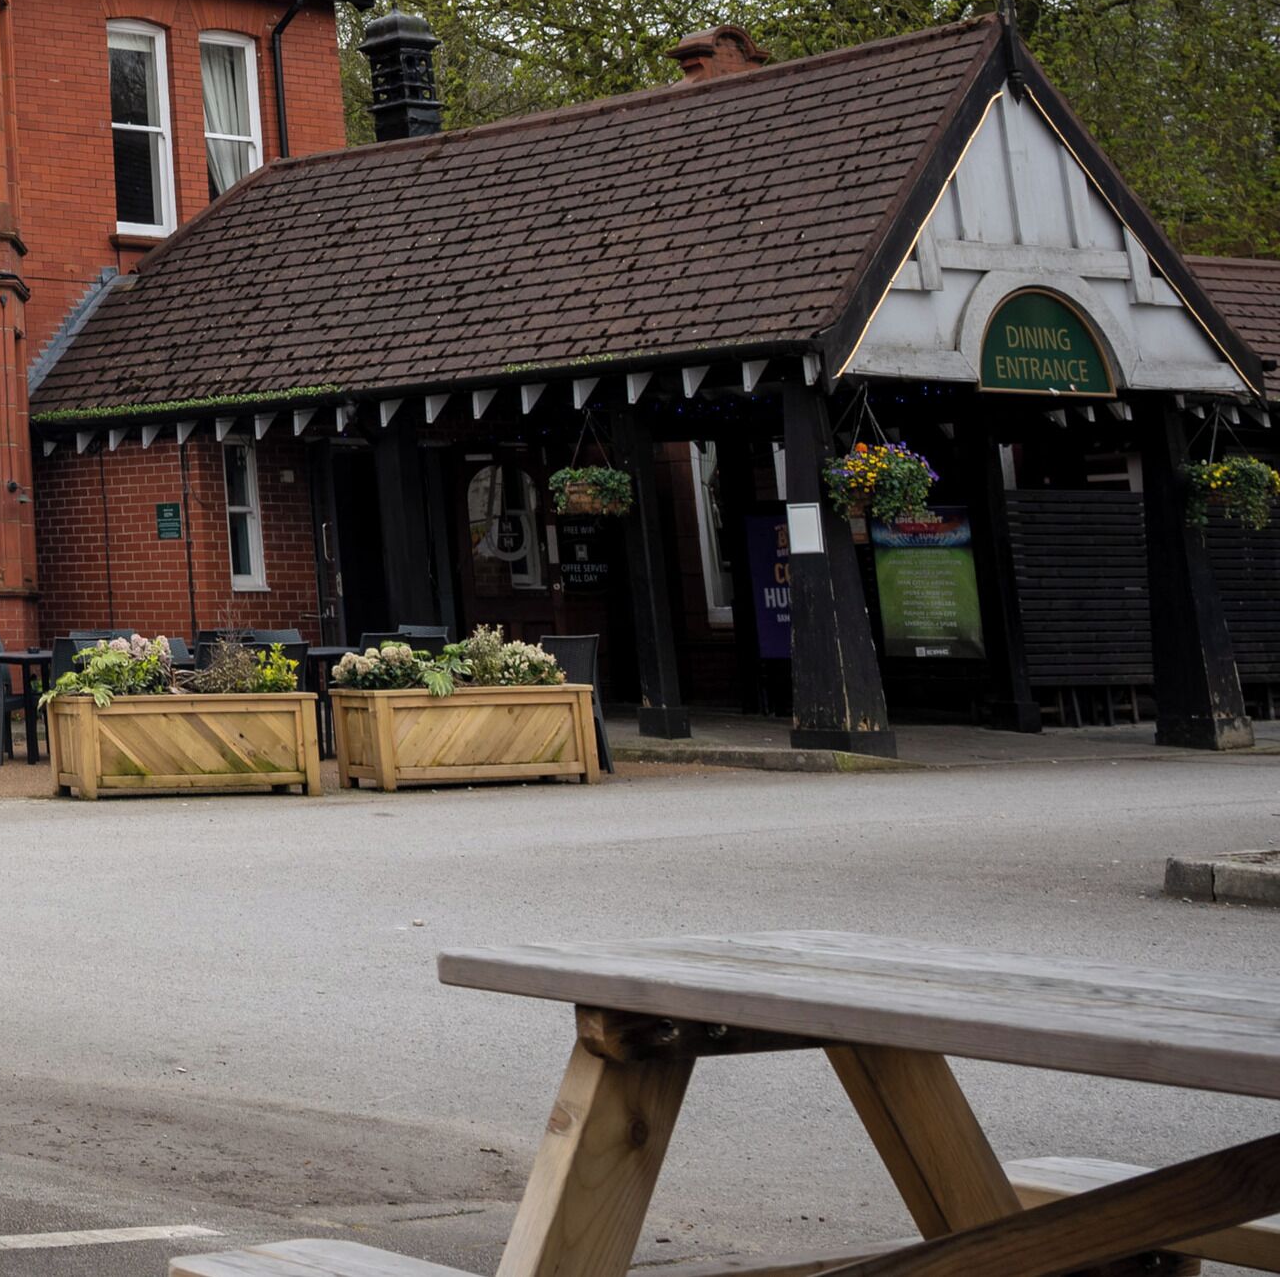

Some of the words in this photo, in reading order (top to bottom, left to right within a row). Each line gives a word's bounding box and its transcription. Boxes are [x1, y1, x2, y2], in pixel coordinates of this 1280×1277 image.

[1005, 325, 1072, 351] DINING
[995, 355, 1089, 383] ENTRANCE
[560, 563, 582, 573] OFFEE
